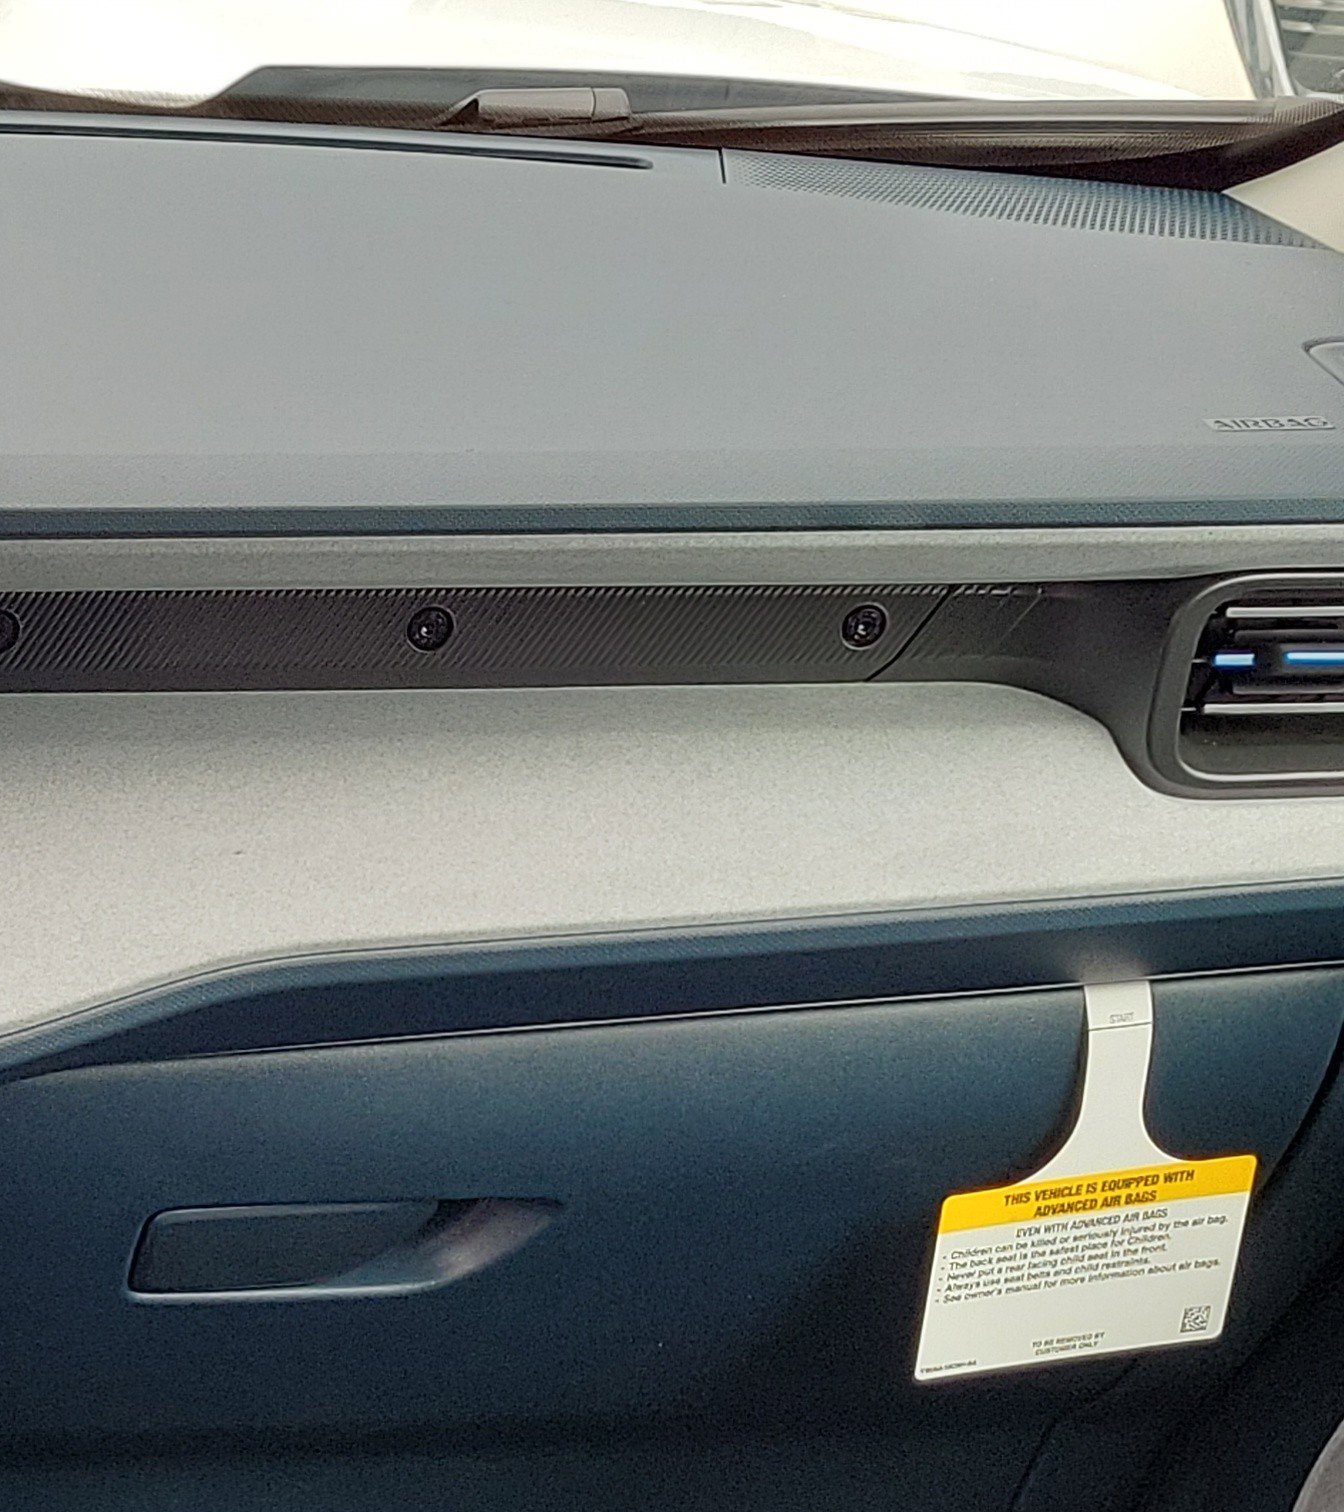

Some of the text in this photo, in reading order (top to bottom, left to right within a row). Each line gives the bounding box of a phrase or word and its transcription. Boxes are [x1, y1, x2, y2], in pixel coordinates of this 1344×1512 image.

[1213, 417, 1328, 430] AIRBAG
[1004, 1170, 1195, 1206] THIS VEHICLE IS EQUIPPED WITH
[1034, 1190, 1157, 1218] ADVANCED AIR BAGS
[1016, 1208, 1168, 1239] EVEN WITH ADVANCED AIR BAGS
[951, 1247, 993, 1260] Children
[995, 1244, 1013, 1253] can
[1016, 1240, 1028, 1250] be
